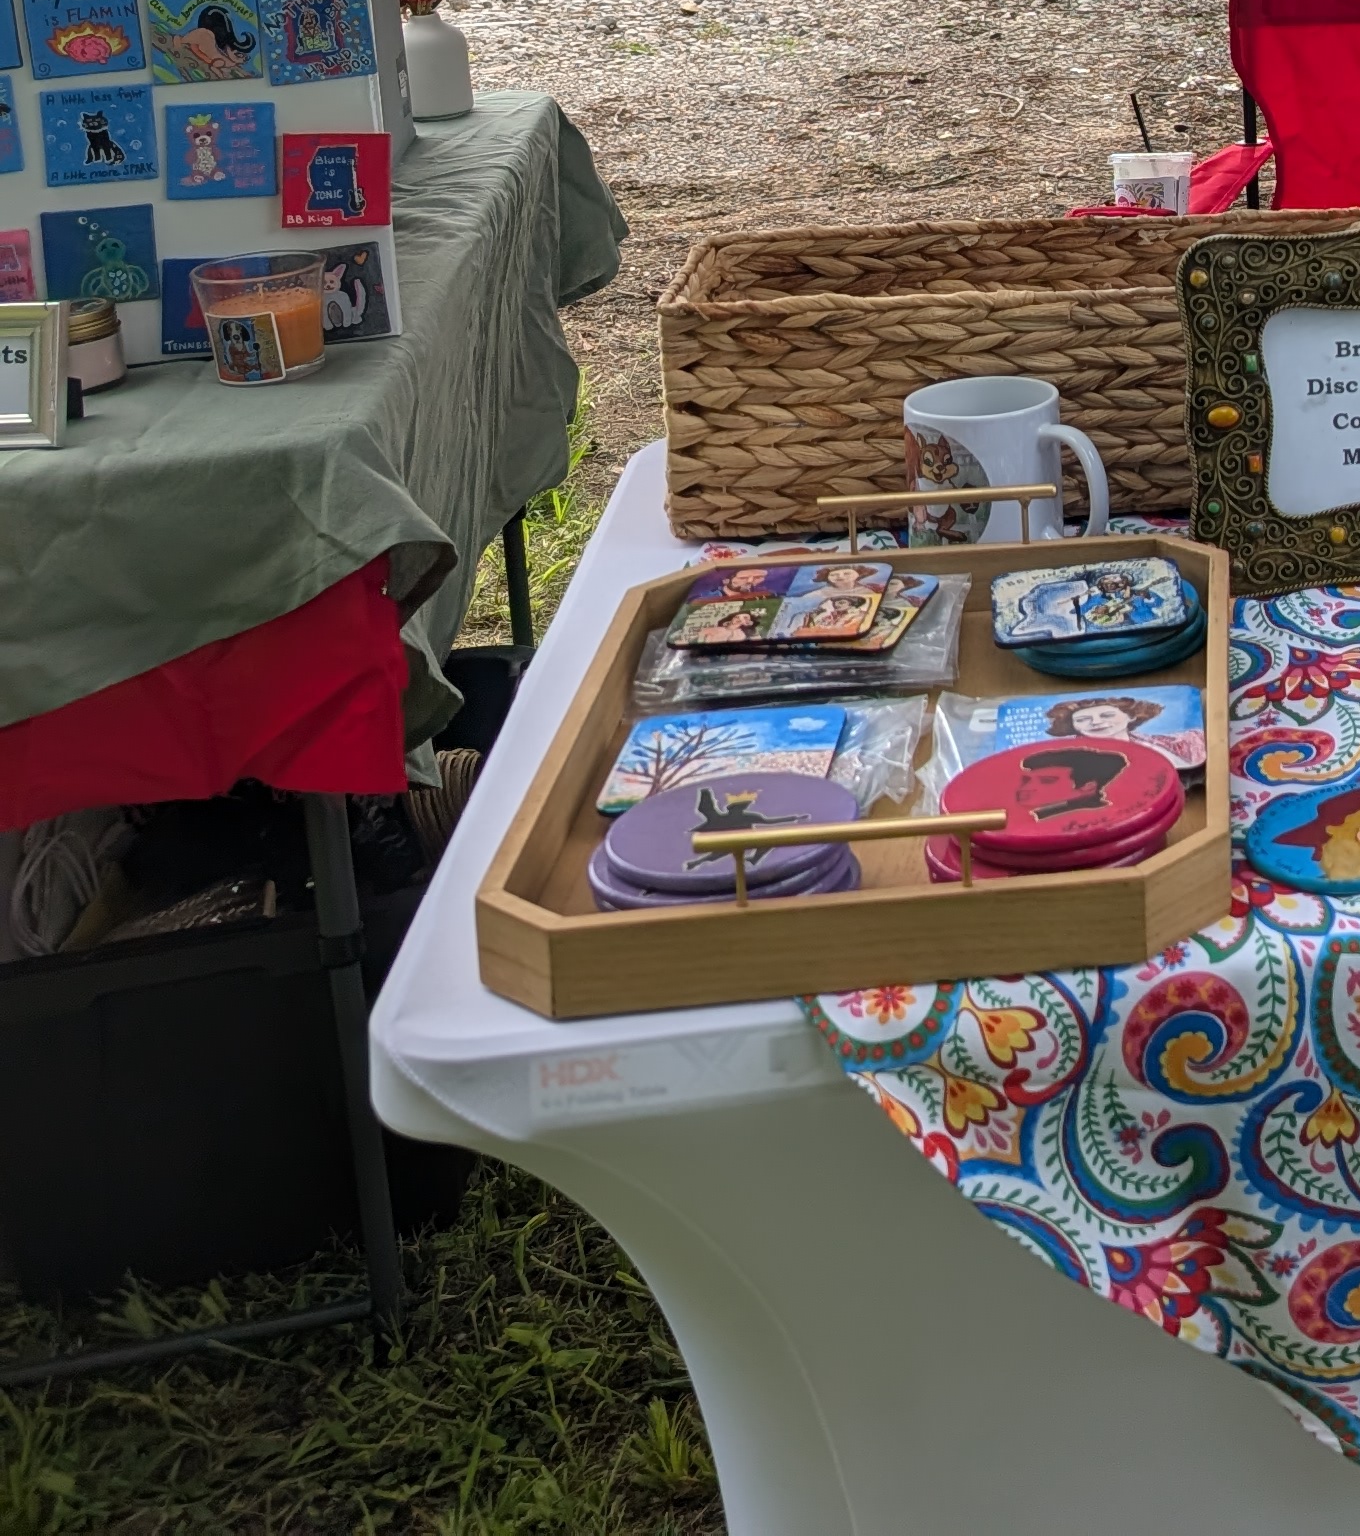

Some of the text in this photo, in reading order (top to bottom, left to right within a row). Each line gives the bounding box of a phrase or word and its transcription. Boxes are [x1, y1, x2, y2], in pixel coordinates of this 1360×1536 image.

[44, 2, 139, 26] is FLAMIN
[303, 48, 352, 80] HOUND
[341, 55, 372, 75] DOG
[46, 95, 54, 105] A
[61, 92, 85, 104] little
[90, 91, 112, 103] less
[315, 155, 347, 165] Blues
[51, 171, 59, 181] A
[90, 168, 121, 180] more
[122, 162, 157, 176] SPARK
[325, 168, 335, 177] is
[315, 189, 343, 200] TONIC
[286, 214, 333, 225] BB King
[1307, 376, 1359, 396] Disc
[539, 1055, 624, 1089] HDX
